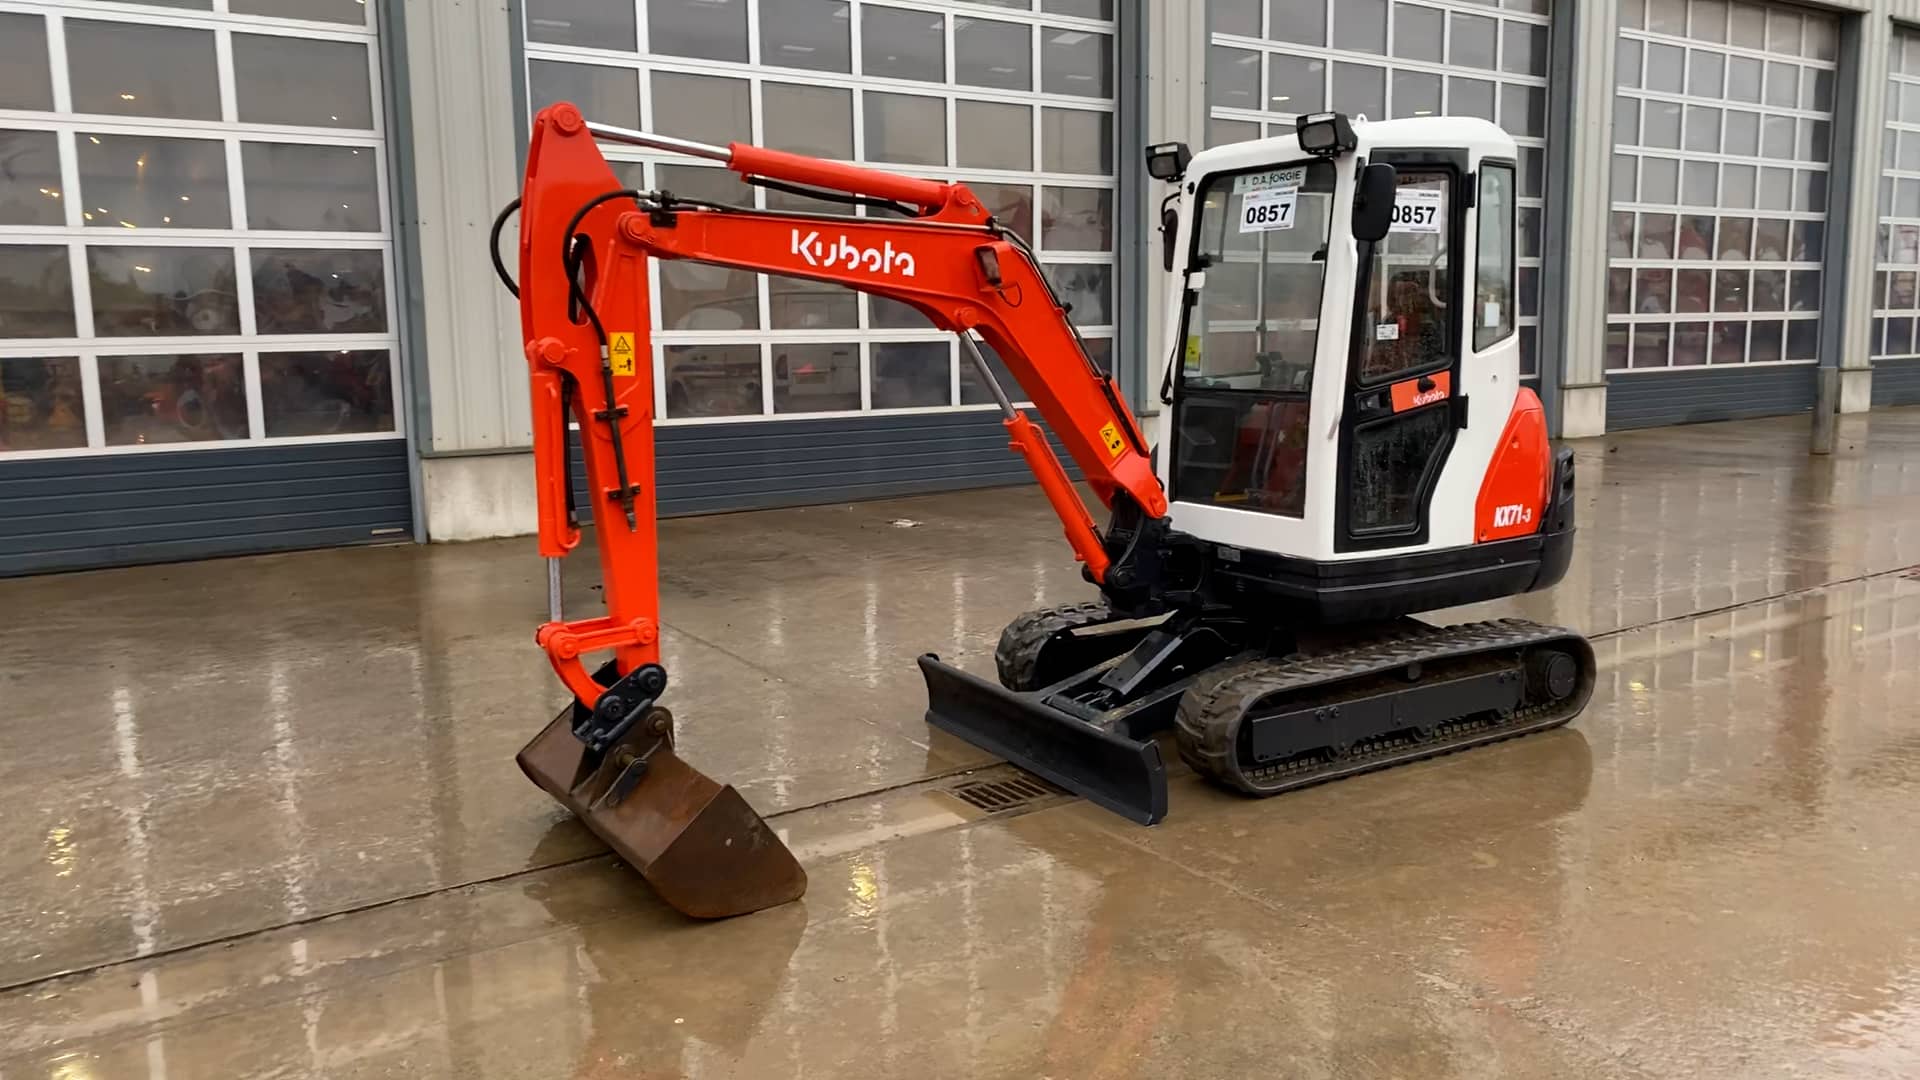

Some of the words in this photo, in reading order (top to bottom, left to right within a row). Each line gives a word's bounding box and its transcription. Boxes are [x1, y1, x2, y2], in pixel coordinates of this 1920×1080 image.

[1246, 203, 1291, 224] 0857
[1391, 205, 1436, 225] 0857
[791, 228, 915, 277] Kubota
[1413, 390, 1445, 405] Kubota
[1494, 503, 1532, 528] KX71-3
